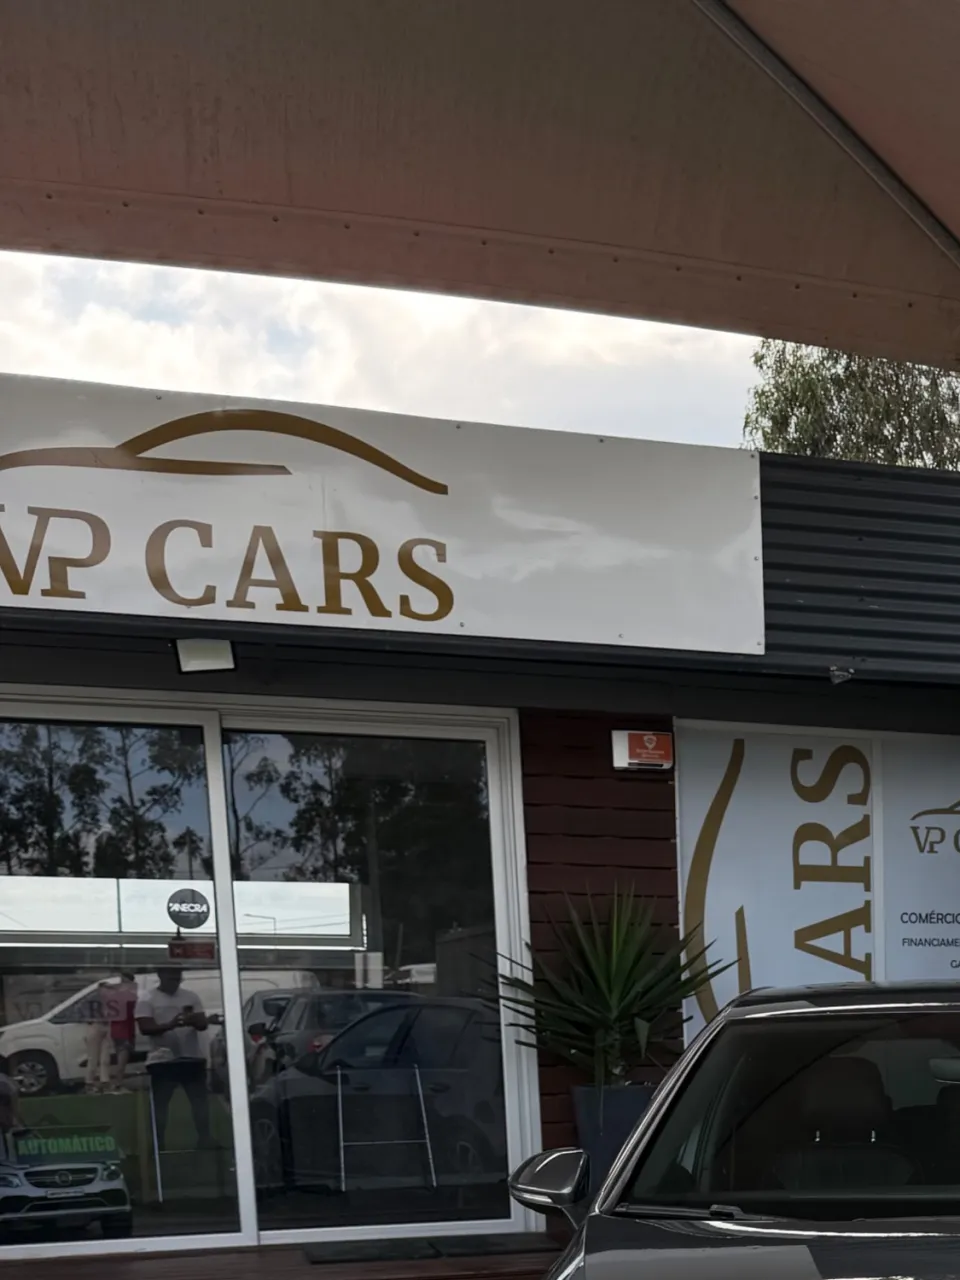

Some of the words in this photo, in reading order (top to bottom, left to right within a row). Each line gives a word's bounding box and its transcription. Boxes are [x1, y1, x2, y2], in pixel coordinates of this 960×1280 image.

[0, 504, 111, 599] VP
[145, 519, 455, 621] CARS
[910, 826, 946, 853] VP
[17, 1134, 116, 1156] AUTOMÁTICO
